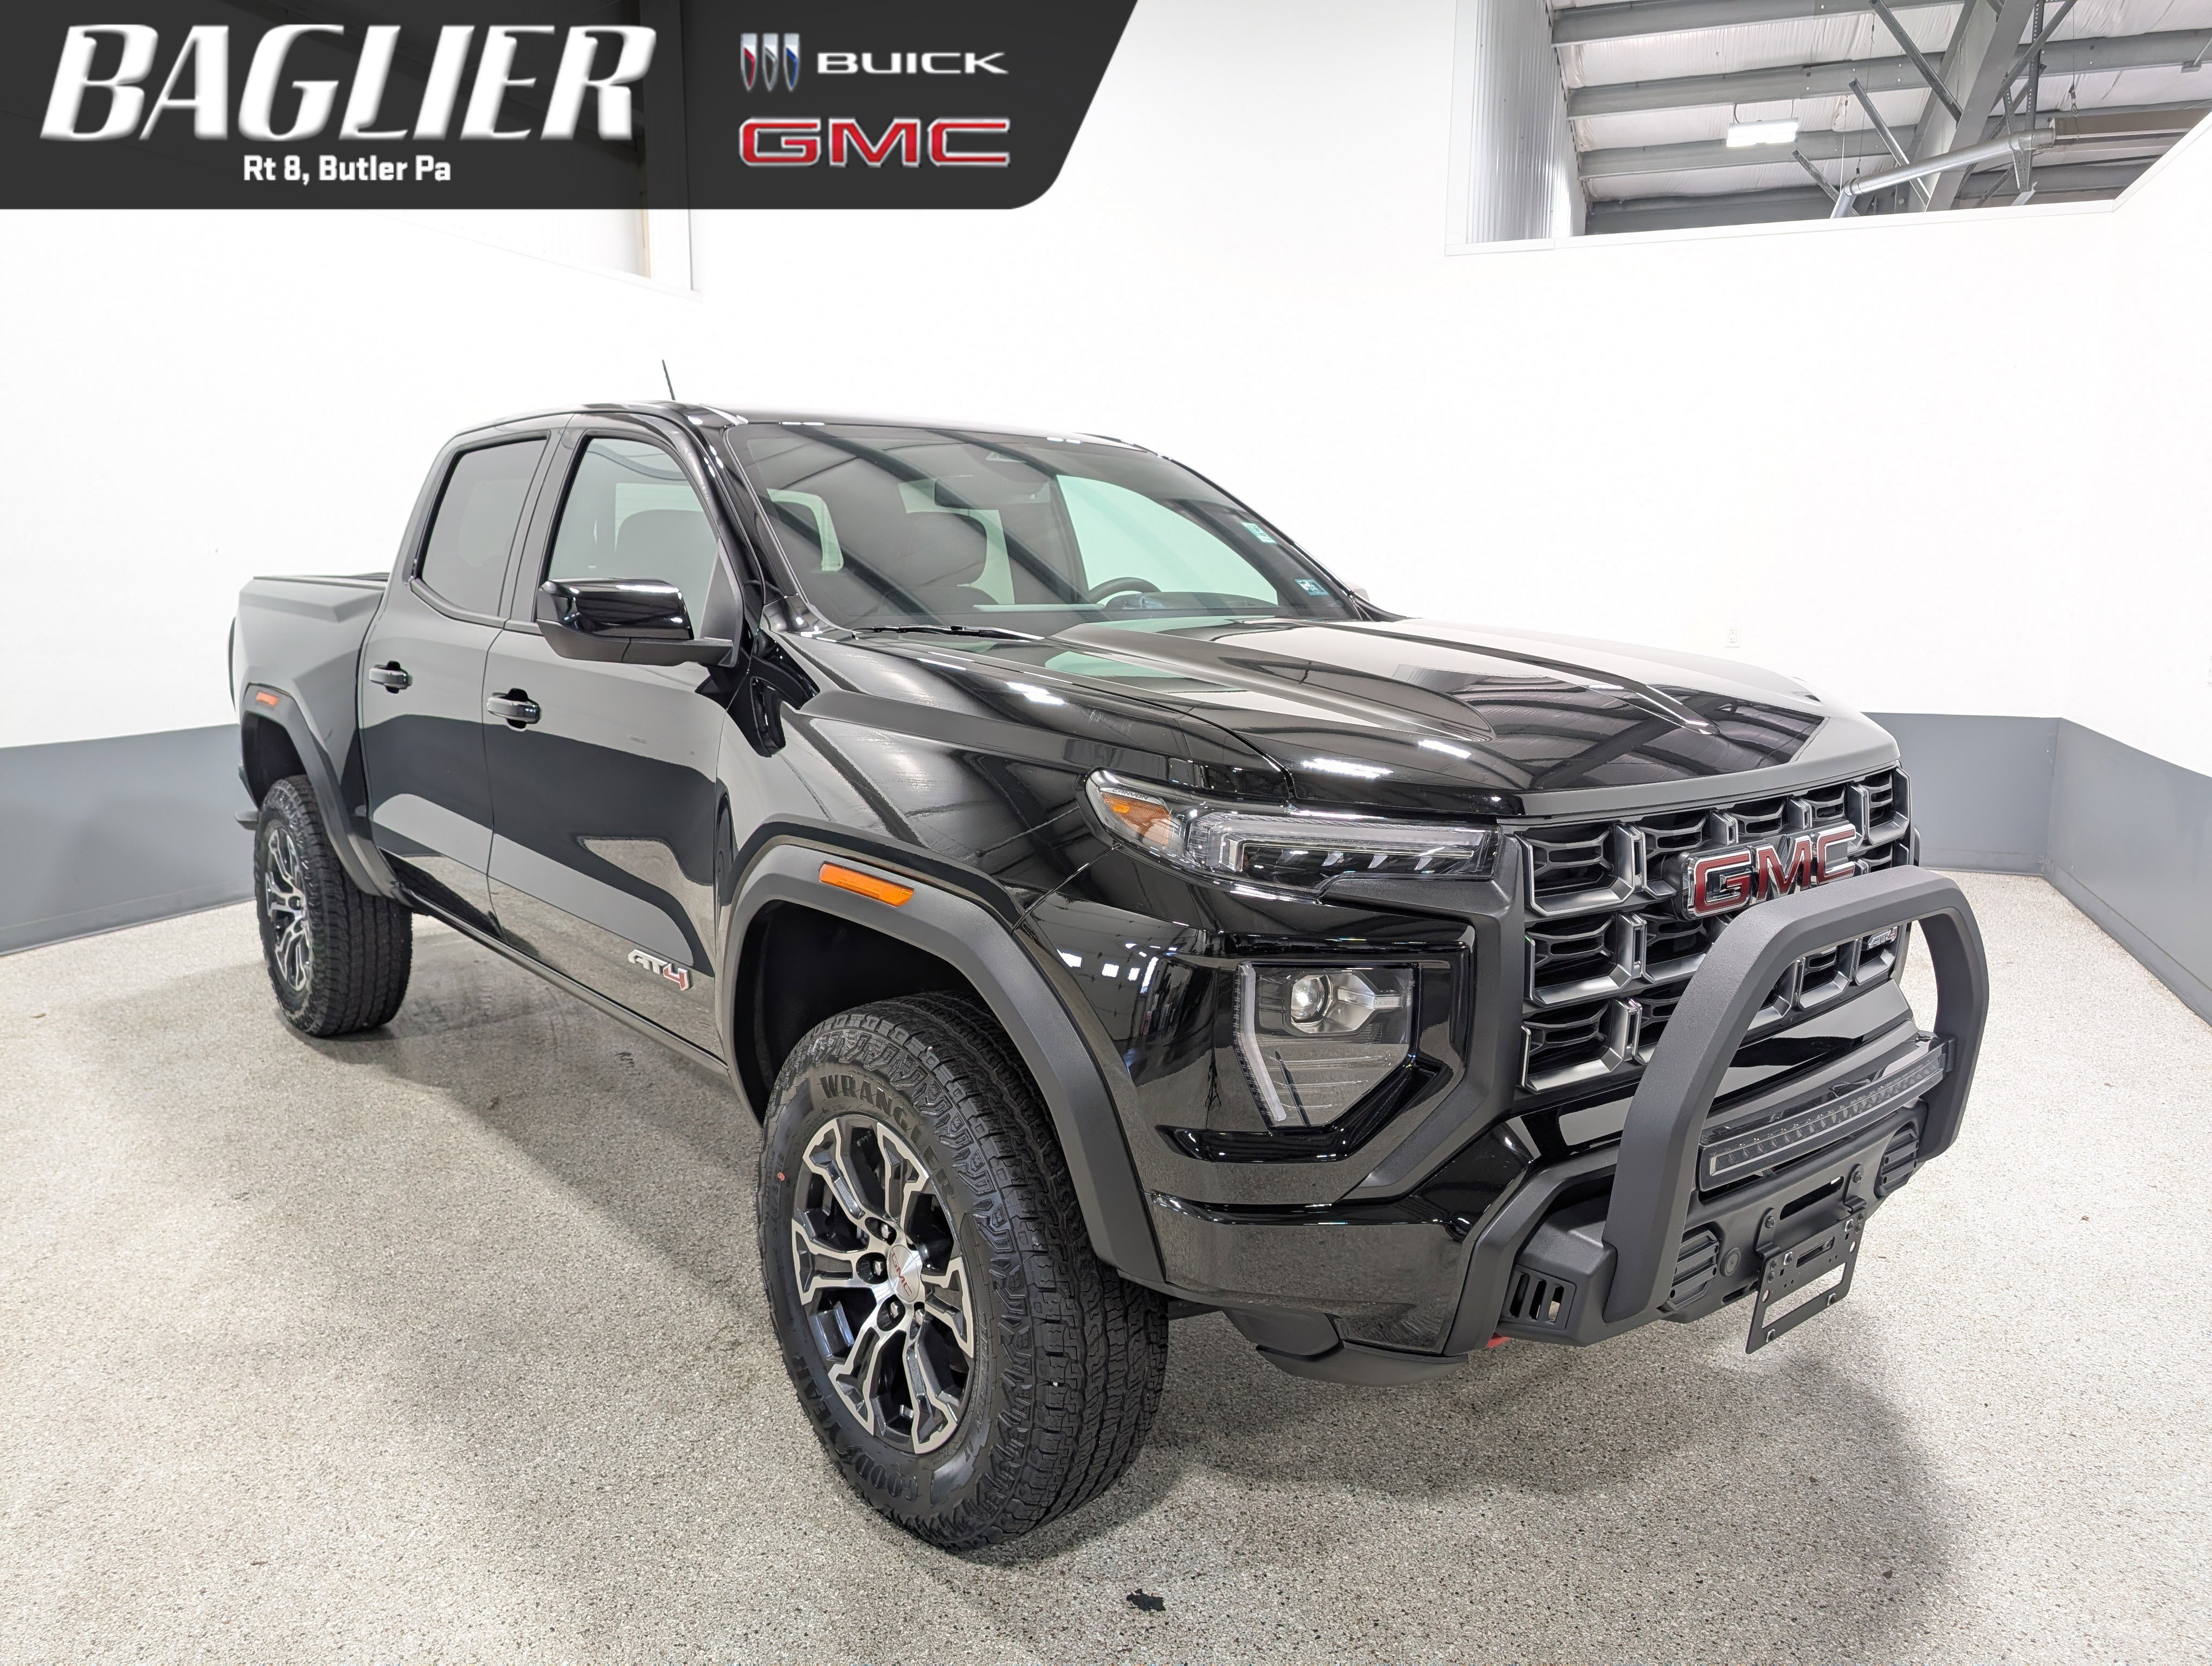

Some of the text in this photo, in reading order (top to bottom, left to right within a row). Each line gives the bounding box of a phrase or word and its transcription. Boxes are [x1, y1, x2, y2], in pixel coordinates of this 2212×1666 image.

[1112, 789, 1149, 800] CANYON
[1687, 823, 1856, 917] GMC
[628, 949, 691, 991] AT4
[819, 1073, 955, 1196] WRANGLER
[891, 1252, 913, 1297] GMC
